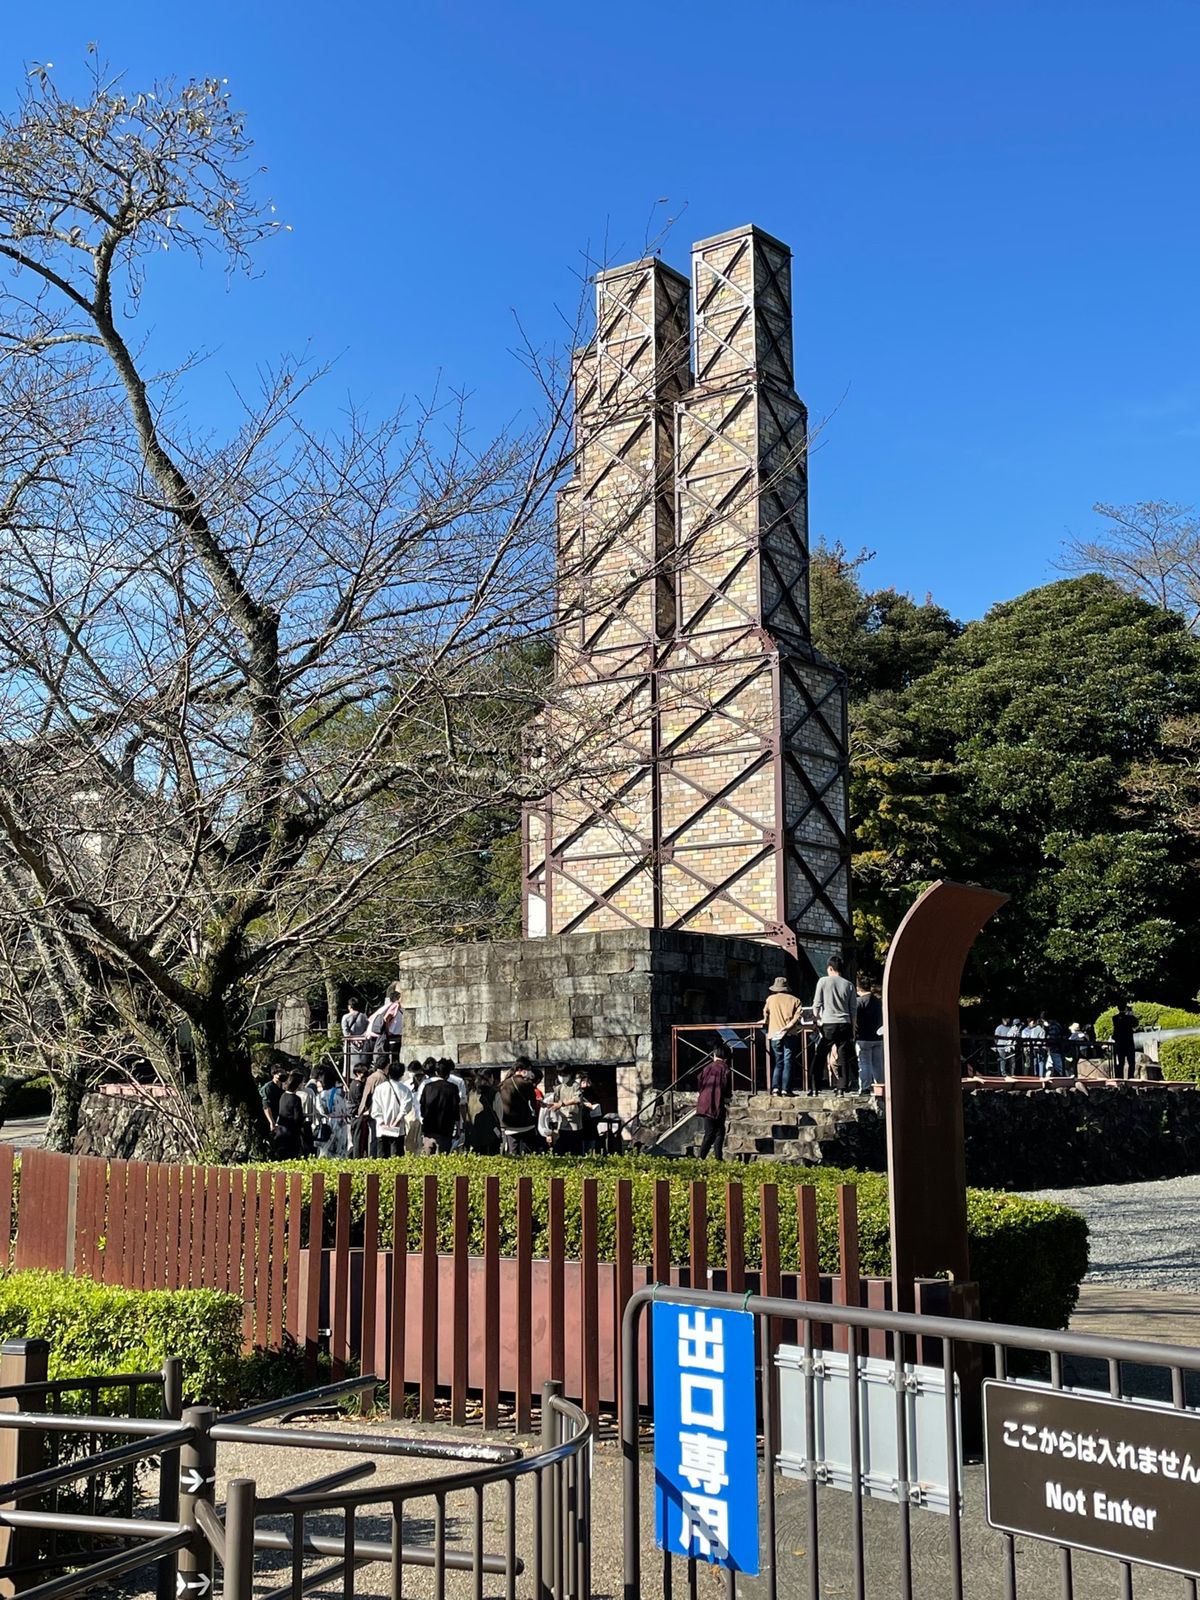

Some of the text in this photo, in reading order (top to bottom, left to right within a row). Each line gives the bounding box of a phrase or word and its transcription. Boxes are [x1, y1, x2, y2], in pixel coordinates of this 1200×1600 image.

[678, 1311, 729, 1560] 出口専用
[1003, 1421, 1200, 1484] ここからは入れません
[1045, 1481, 1157, 1531] Not Enter
